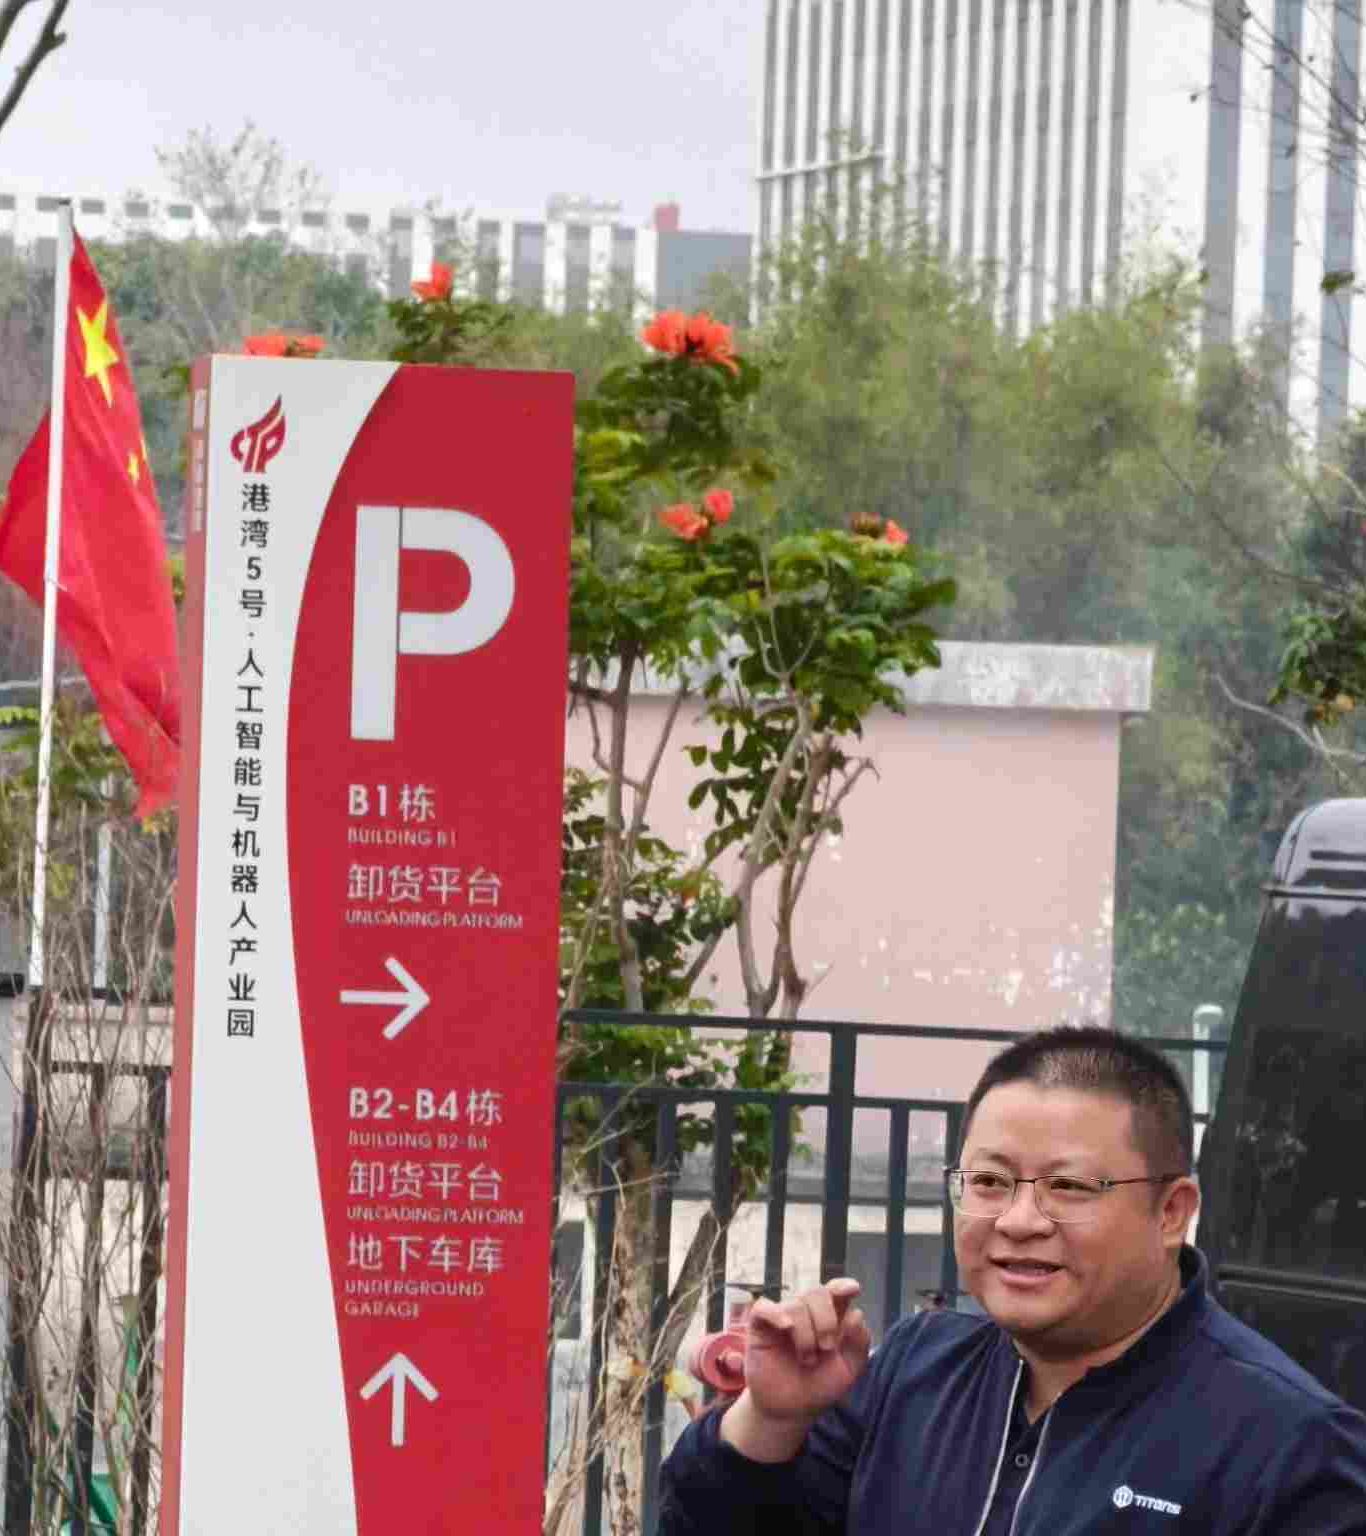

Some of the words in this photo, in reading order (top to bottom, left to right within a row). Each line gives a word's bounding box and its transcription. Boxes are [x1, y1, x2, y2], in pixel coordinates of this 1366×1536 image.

[351, 505, 516, 740] P
[226, 482, 271, 1038] 港湾5号·人工智能与机器人产业园
[347, 783, 437, 823] B1栋
[347, 826, 433, 847] BUILDING
[346, 862, 503, 907] 卸货平台
[346, 908, 441, 928] UNLOADING
[442, 911, 523, 929] PLATFORM
[348, 1086, 504, 1127] B2-B4栋
[348, 1129, 433, 1149] BUILDING
[347, 1159, 503, 1202] 卸货平台
[346, 1204, 442, 1224] UNLOADING
[443, 1207, 523, 1225] PLATFORM
[346, 1231, 505, 1275] 地下车库
[344, 1278, 485, 1298] UNDERGROUND
